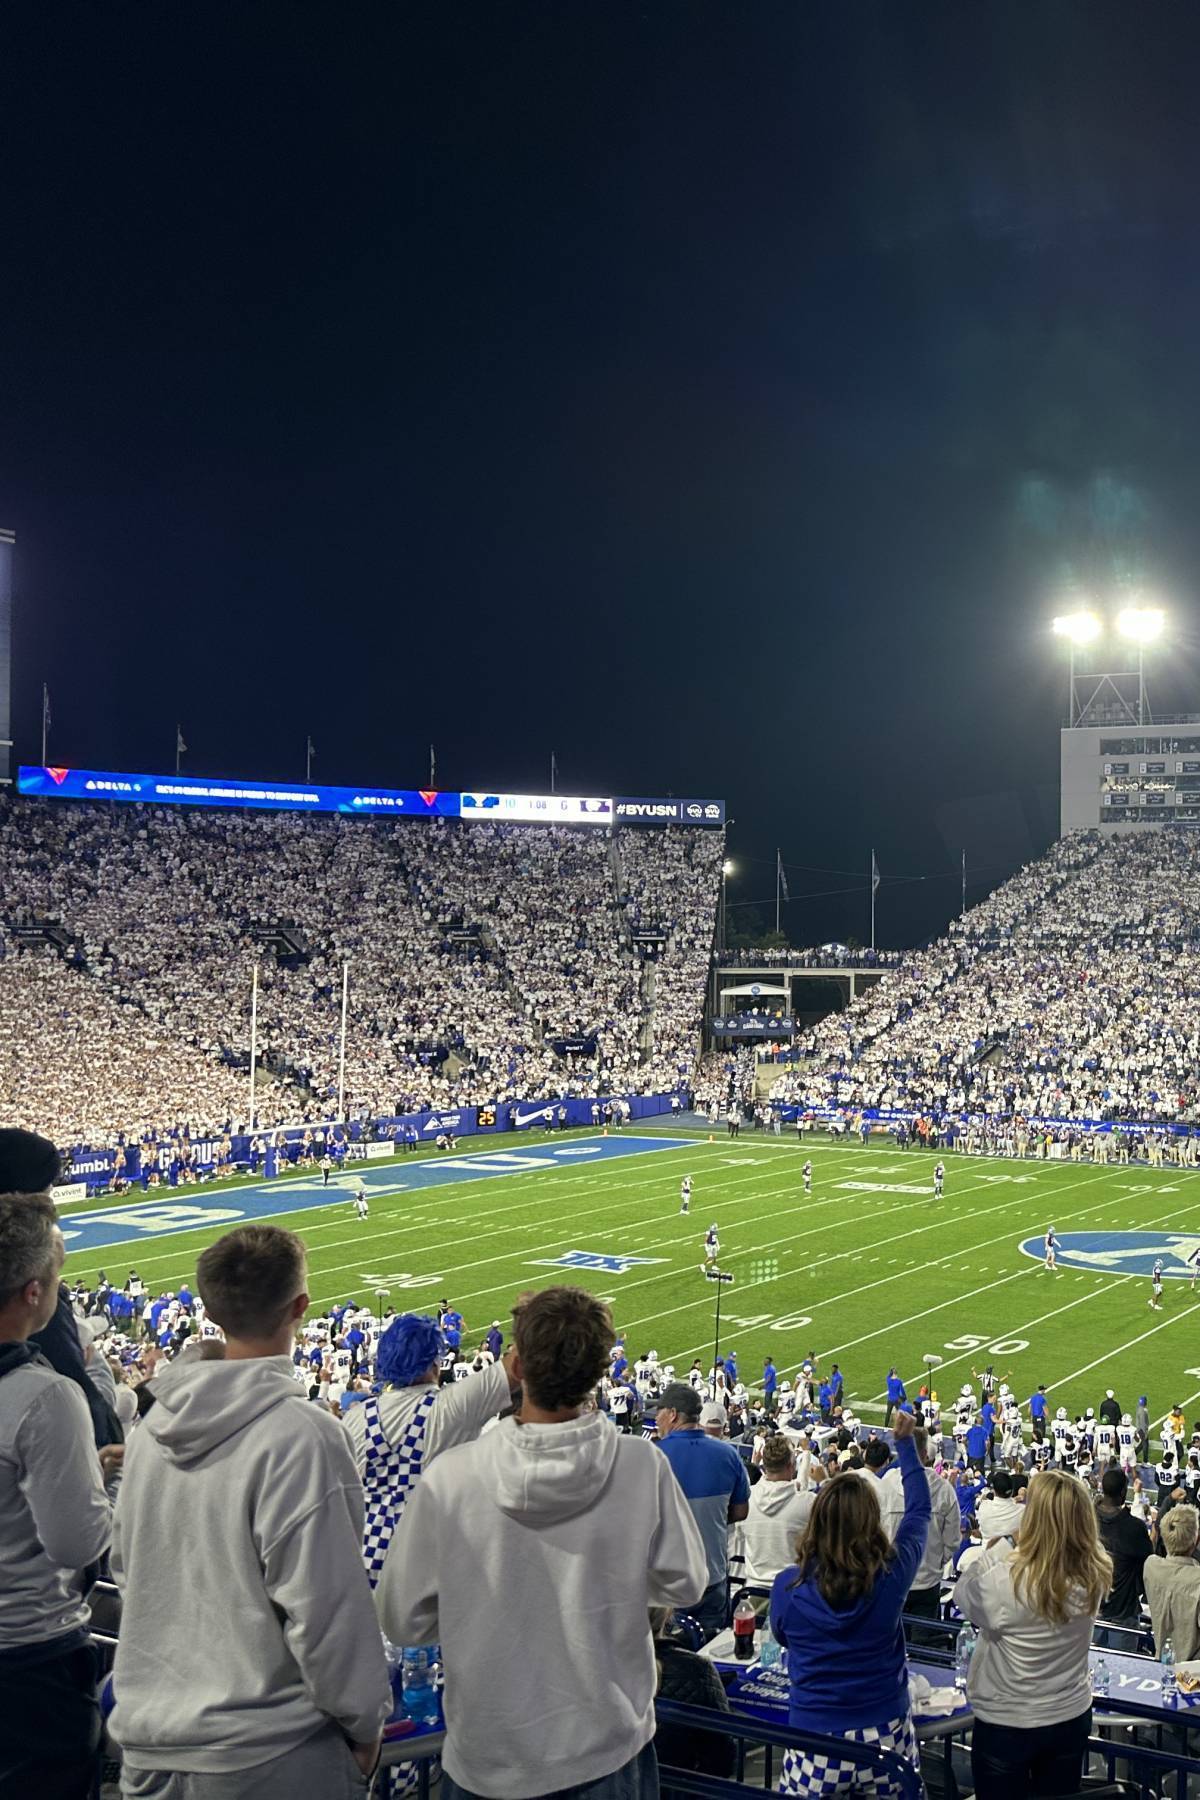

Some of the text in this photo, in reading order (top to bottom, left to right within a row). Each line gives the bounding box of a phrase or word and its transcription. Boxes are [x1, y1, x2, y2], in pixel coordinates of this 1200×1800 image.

[97, 781, 132, 792] DELTA
[362, 798, 395, 806] DELTA
[505, 800, 516, 809] 10
[616, 804, 677, 817] #BYUSN
[479, 1112, 495, 1126] 25
[731, 1313, 813, 1331] 40
[204, 1326, 215, 1336] 63
[943, 1334, 1030, 1355] 50
[639, 1370, 650, 1380] 16
[613, 1396, 626, 1406] 77
[1055, 1428, 1065, 1439] 31
[1099, 1432, 1111, 1444] 10
[1120, 1434, 1132, 1445] 18
[1159, 1472, 1172, 1483] 82
